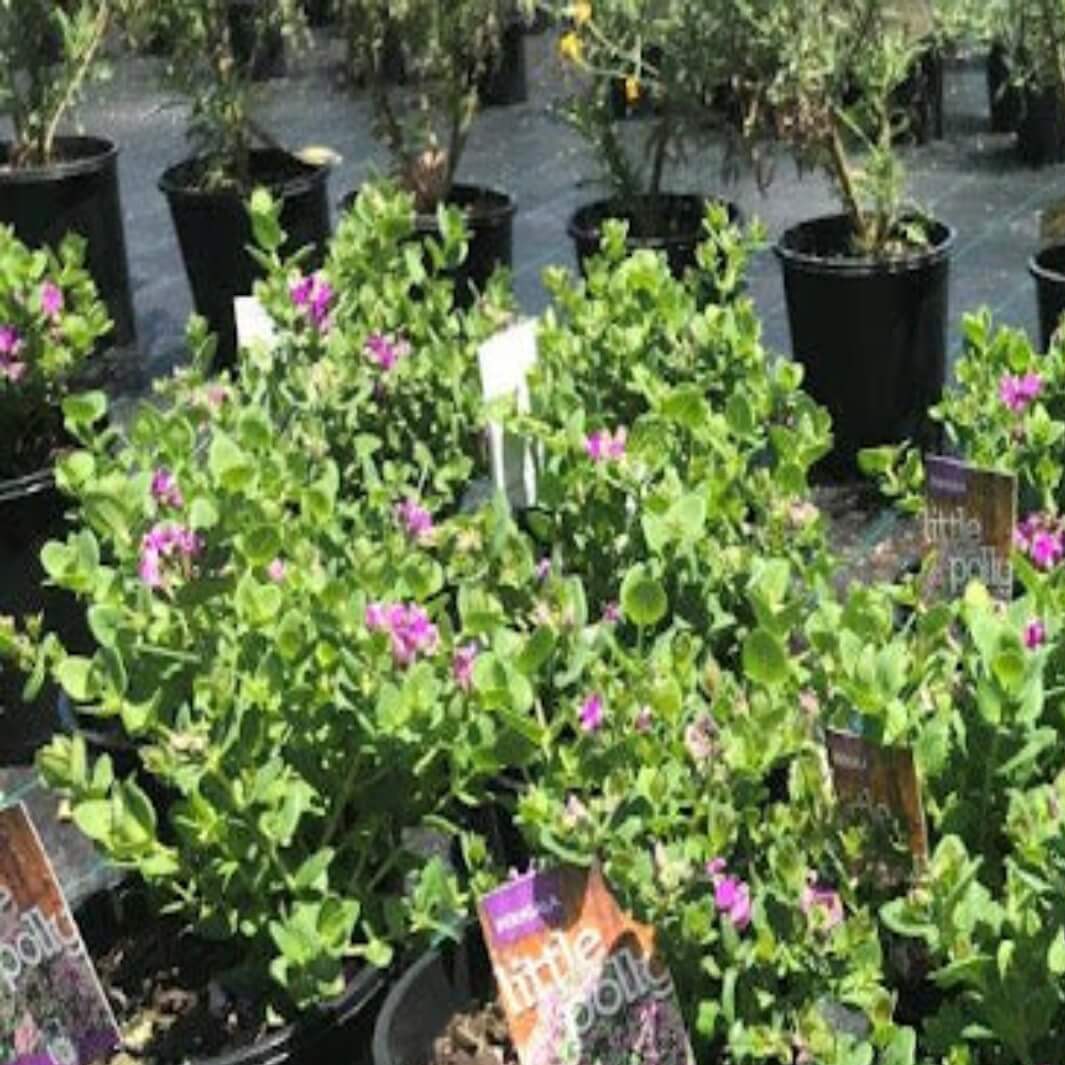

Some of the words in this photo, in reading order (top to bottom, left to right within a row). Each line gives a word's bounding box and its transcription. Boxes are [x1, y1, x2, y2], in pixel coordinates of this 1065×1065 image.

[924, 505, 980, 545] little
[951, 546, 1014, 599] polly
[494, 928, 602, 1016] little
[565, 948, 673, 1056] polly
